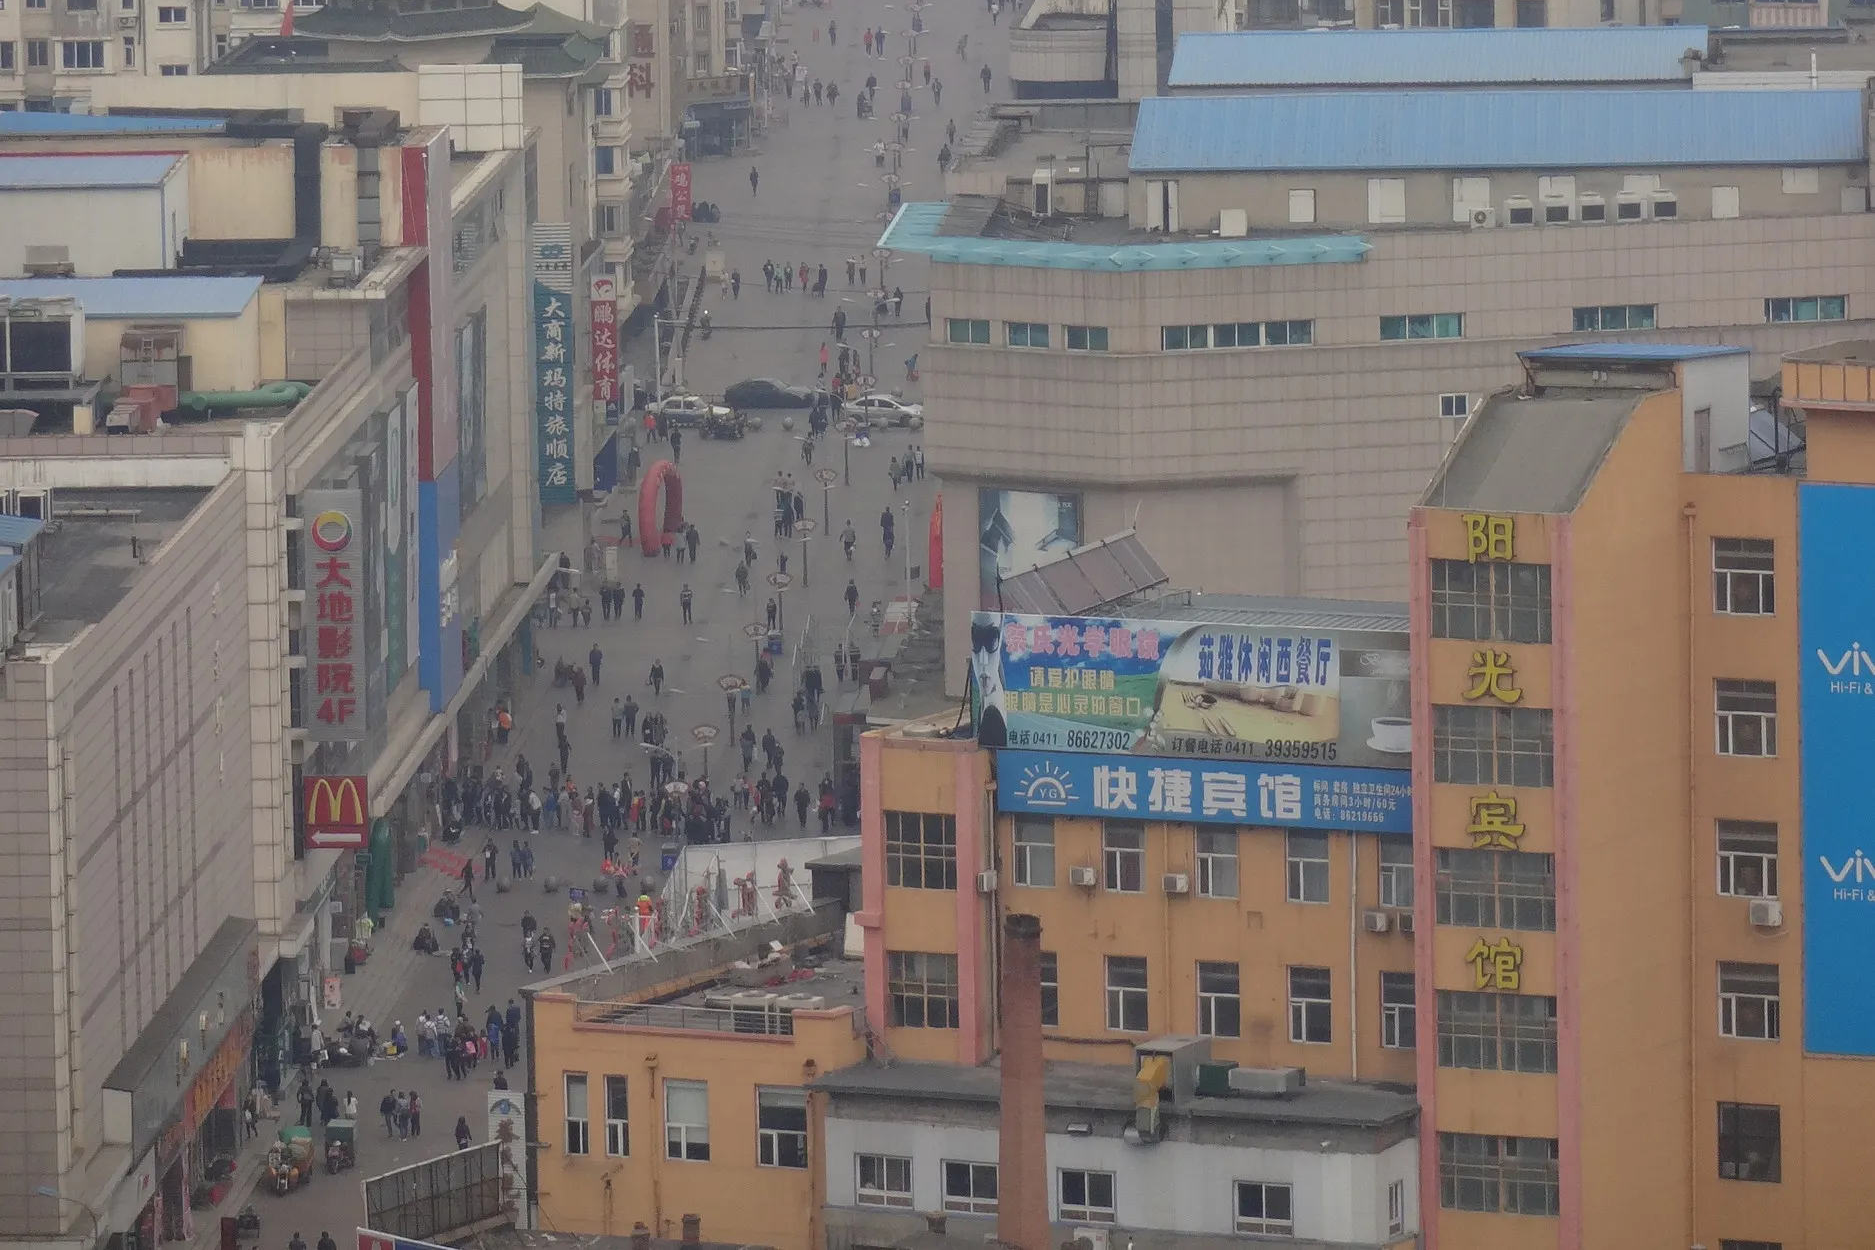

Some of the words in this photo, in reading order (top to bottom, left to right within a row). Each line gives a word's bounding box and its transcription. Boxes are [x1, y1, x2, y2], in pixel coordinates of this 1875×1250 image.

[593, 302, 616, 401] 鹏达体育
[539, 297, 570, 487] 大商新玛特旅顺店
[1030, 666, 1116, 690] 请爱护眼睛
[1831, 681, 1861, 694] Hi-Fi
[1864, 683, 1873, 694] &
[1005, 691, 1141, 717] 眼睛是心灵的窗口
[1462, 513, 1525, 992] 阳光宾馆
[1039, 788, 1057, 799] YG
[1093, 765, 1302, 819] 快捷宾馆
[1833, 888, 1863, 901] Hi-Fi
